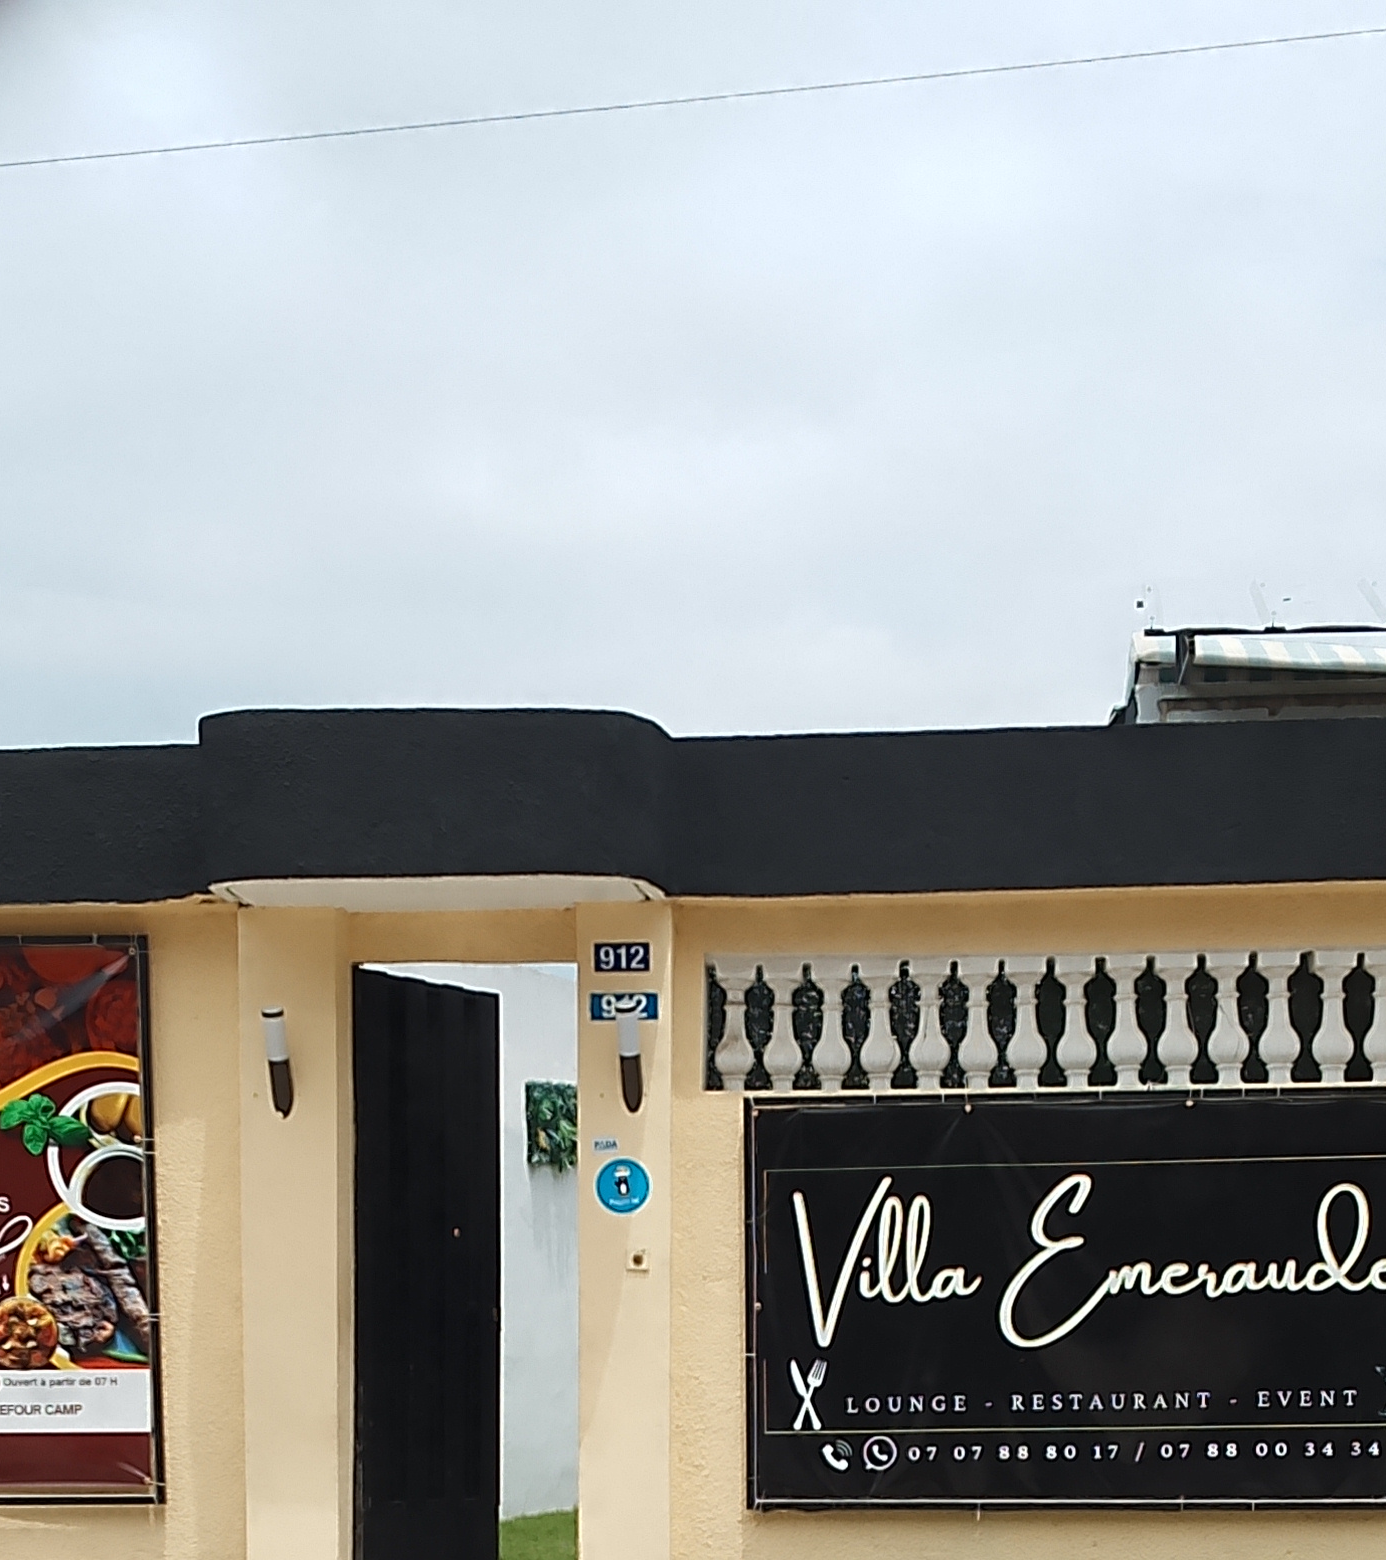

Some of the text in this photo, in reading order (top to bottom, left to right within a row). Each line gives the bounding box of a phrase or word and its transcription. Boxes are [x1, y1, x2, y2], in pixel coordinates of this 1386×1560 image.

[599, 945, 645, 970] 912
[793, 1176, 982, 1348] Villa
[3, 1377, 37, 1386] Ouvert
[45, 1404, 83, 1415] CAMP
[845, 1395, 968, 1415] LOUNGE
[1012, 1391, 1212, 1413] RESTAURANT
[1257, 1389, 1359, 1409] EVENT
[908, 1441, 1382, 1463] 07 07 88 80 17 / 07 88 00 34 34
